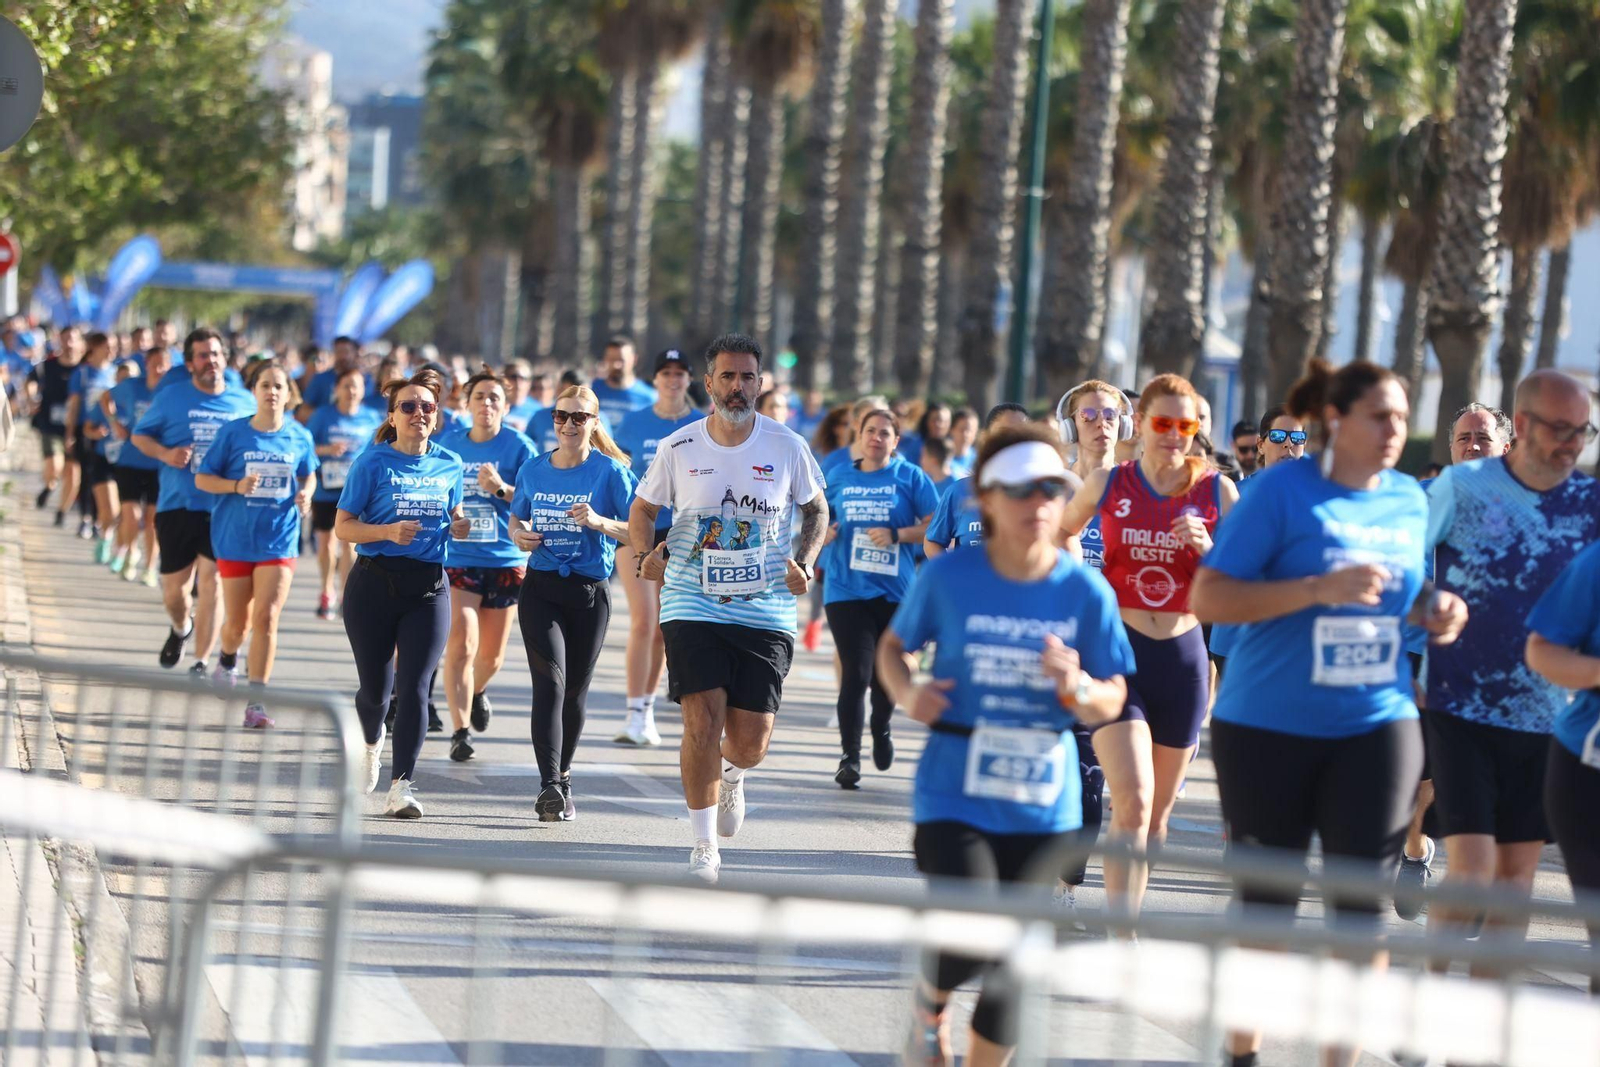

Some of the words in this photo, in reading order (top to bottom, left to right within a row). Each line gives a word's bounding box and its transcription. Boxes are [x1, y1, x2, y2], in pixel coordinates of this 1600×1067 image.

[390, 474, 449, 488] mayoral
[842, 484, 897, 496] mayoral
[397, 501, 443, 509] MAKES
[533, 491, 593, 506] mayoral
[396, 508, 443, 517] FRIENDS
[1114, 498, 1132, 517] 3
[536, 524, 583, 533] FRIENDS
[860, 549, 890, 564] 290
[1129, 546, 1176, 564] OESTE
[711, 566, 758, 582] 1223
